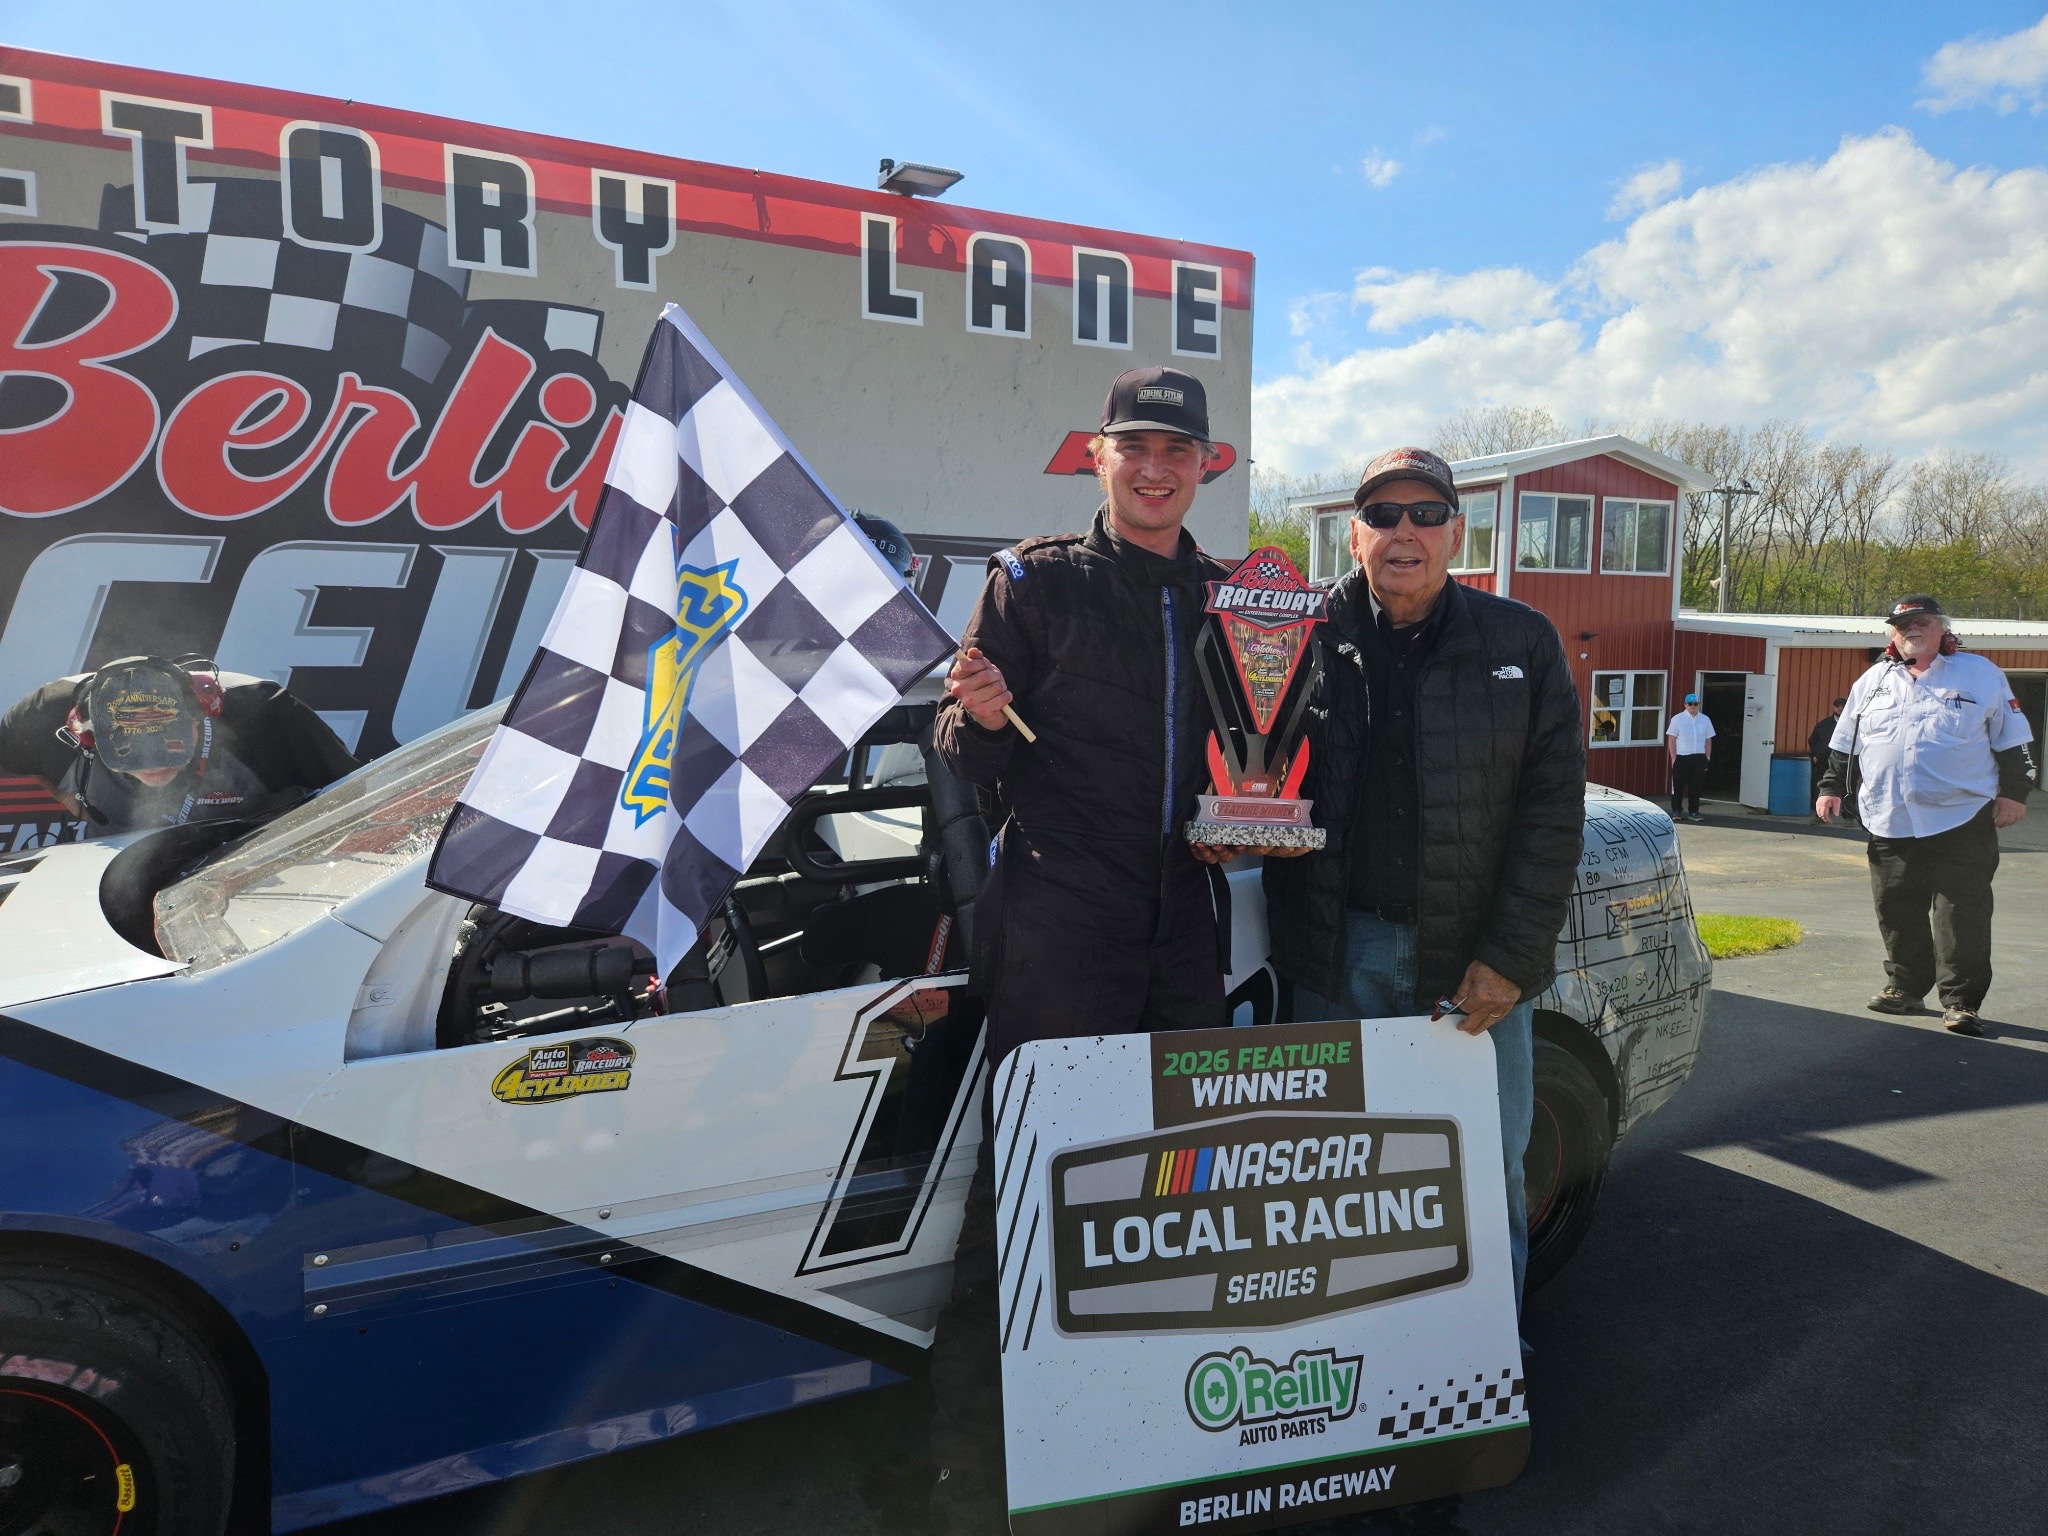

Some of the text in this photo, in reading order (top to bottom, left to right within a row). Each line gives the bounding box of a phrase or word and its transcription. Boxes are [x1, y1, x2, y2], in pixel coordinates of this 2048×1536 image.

[860, 211, 1222, 360] LANE
[0, 241, 624, 534] Berli
[1240, 568, 1299, 591] Berlin
[1213, 585, 1324, 615] RACEWAY
[125, 694, 178, 706] ANNIVERSARY
[146, 725, 164, 733] 2026
[1605, 846, 1629, 861] CFM
[1635, 972, 1649, 986] SA
[531, 1057, 632, 1073] Value RACEWAY
[533, 1049, 565, 1061] Auto
[1163, 1041, 1352, 1077] 2026 FEATURE
[1191, 1069, 1327, 1108] WINNER
[1210, 1133, 1372, 1191] NASCAR
[1082, 1185, 1444, 1268] LOCAL RACING
[1226, 1266, 1317, 1304] SERIES
[1193, 1354, 1358, 1424] O'Reilly
[1239, 1417, 1327, 1447] AUTO PARTS
[1179, 1464, 1397, 1527] BERLIN RACEWAY
